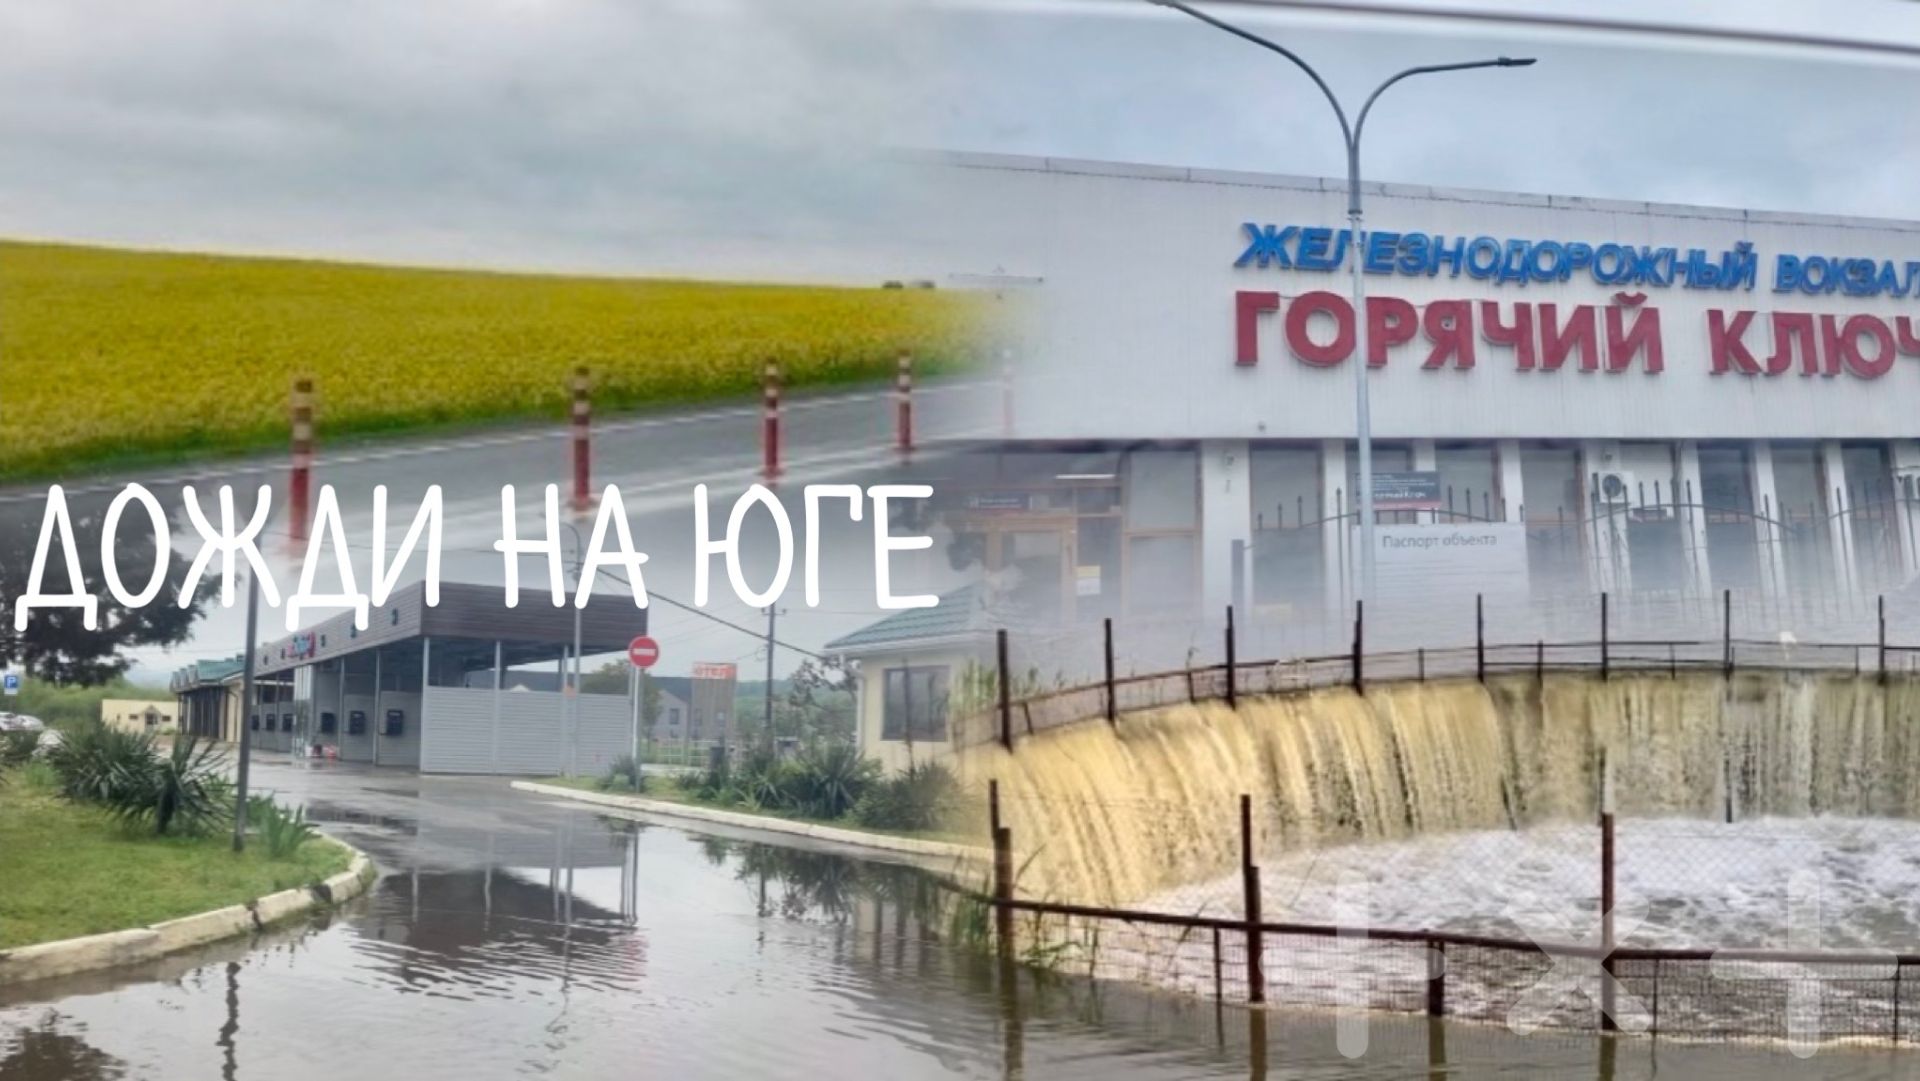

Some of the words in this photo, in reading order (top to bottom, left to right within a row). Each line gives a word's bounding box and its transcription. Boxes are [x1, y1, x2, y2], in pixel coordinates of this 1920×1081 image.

[1235, 222, 1757, 289] ЖЕЛЕЗНОДОРОЖНЫЙ
[1234, 290, 1664, 374] ГОРЯЧИЙ
[1382, 534, 1439, 550] Паспорт
[1443, 531, 1498, 547] объекта
